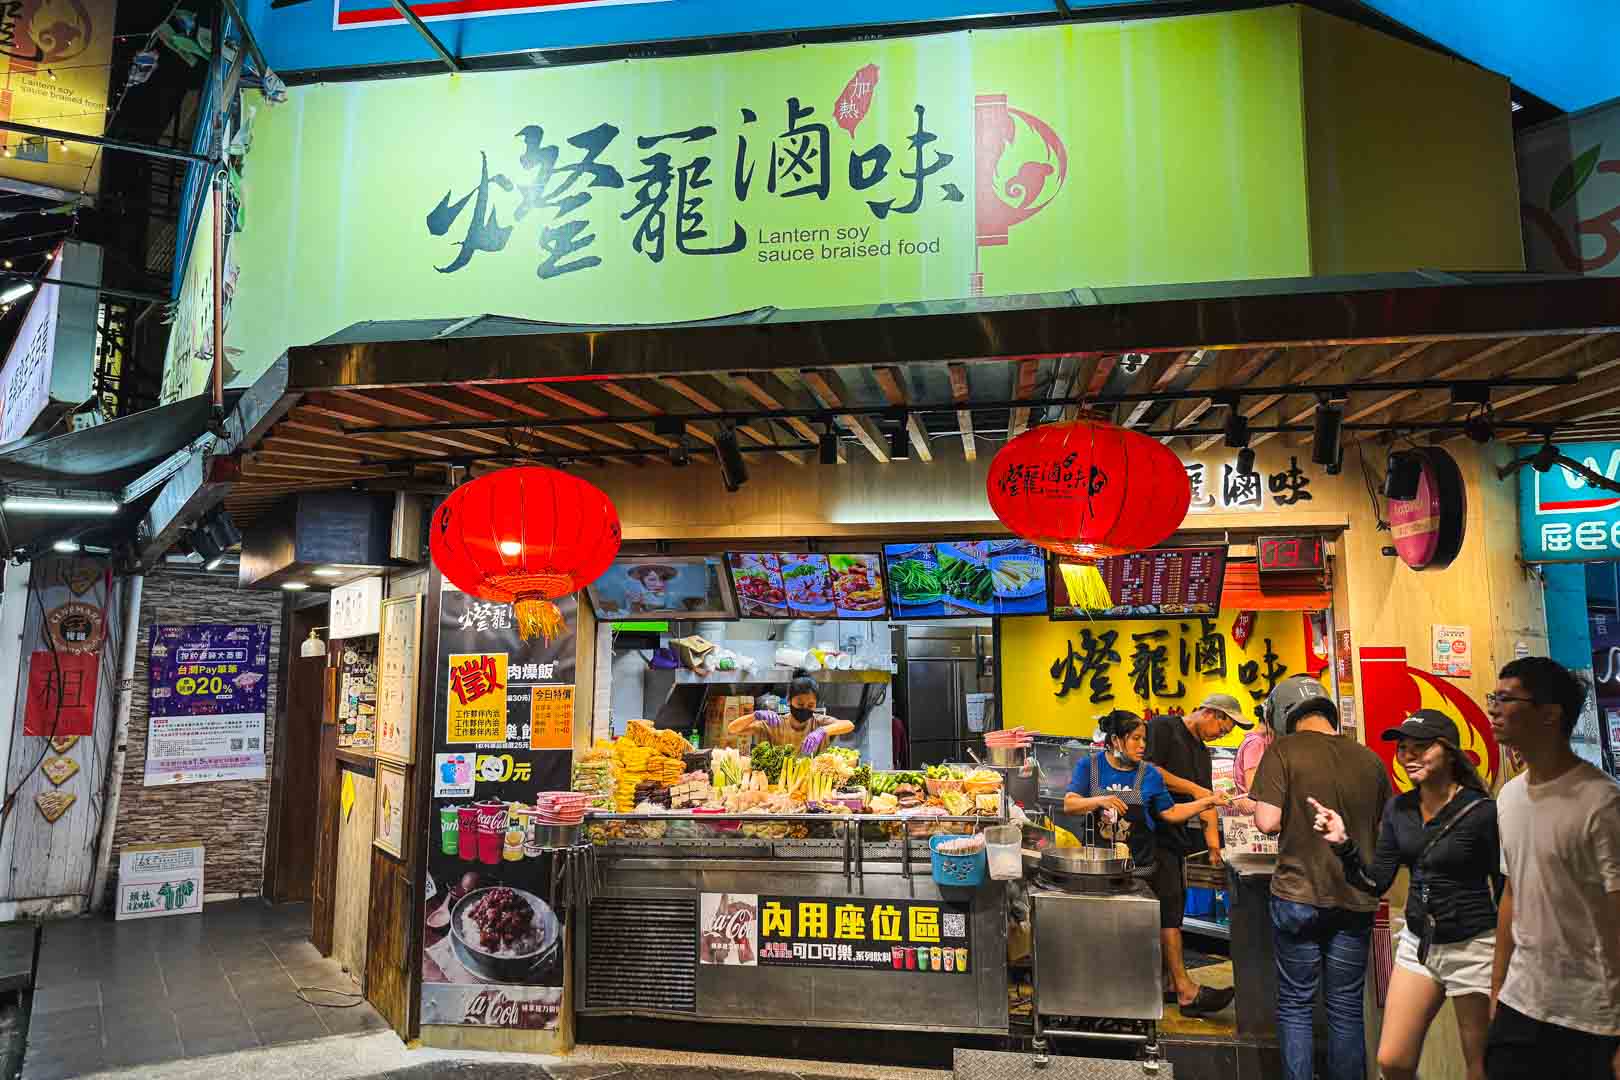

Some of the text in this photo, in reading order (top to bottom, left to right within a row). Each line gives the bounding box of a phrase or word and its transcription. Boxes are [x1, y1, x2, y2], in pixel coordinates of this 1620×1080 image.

[840, 77, 872, 119] 加熱
[758, 226, 870, 244] Lantern soy
[758, 237, 941, 262] sauce braised food
[1541, 520, 1620, 552] 屈臣
[535, 689, 571, 702] 今日特價
[762, 901, 941, 943] 內用座位區
